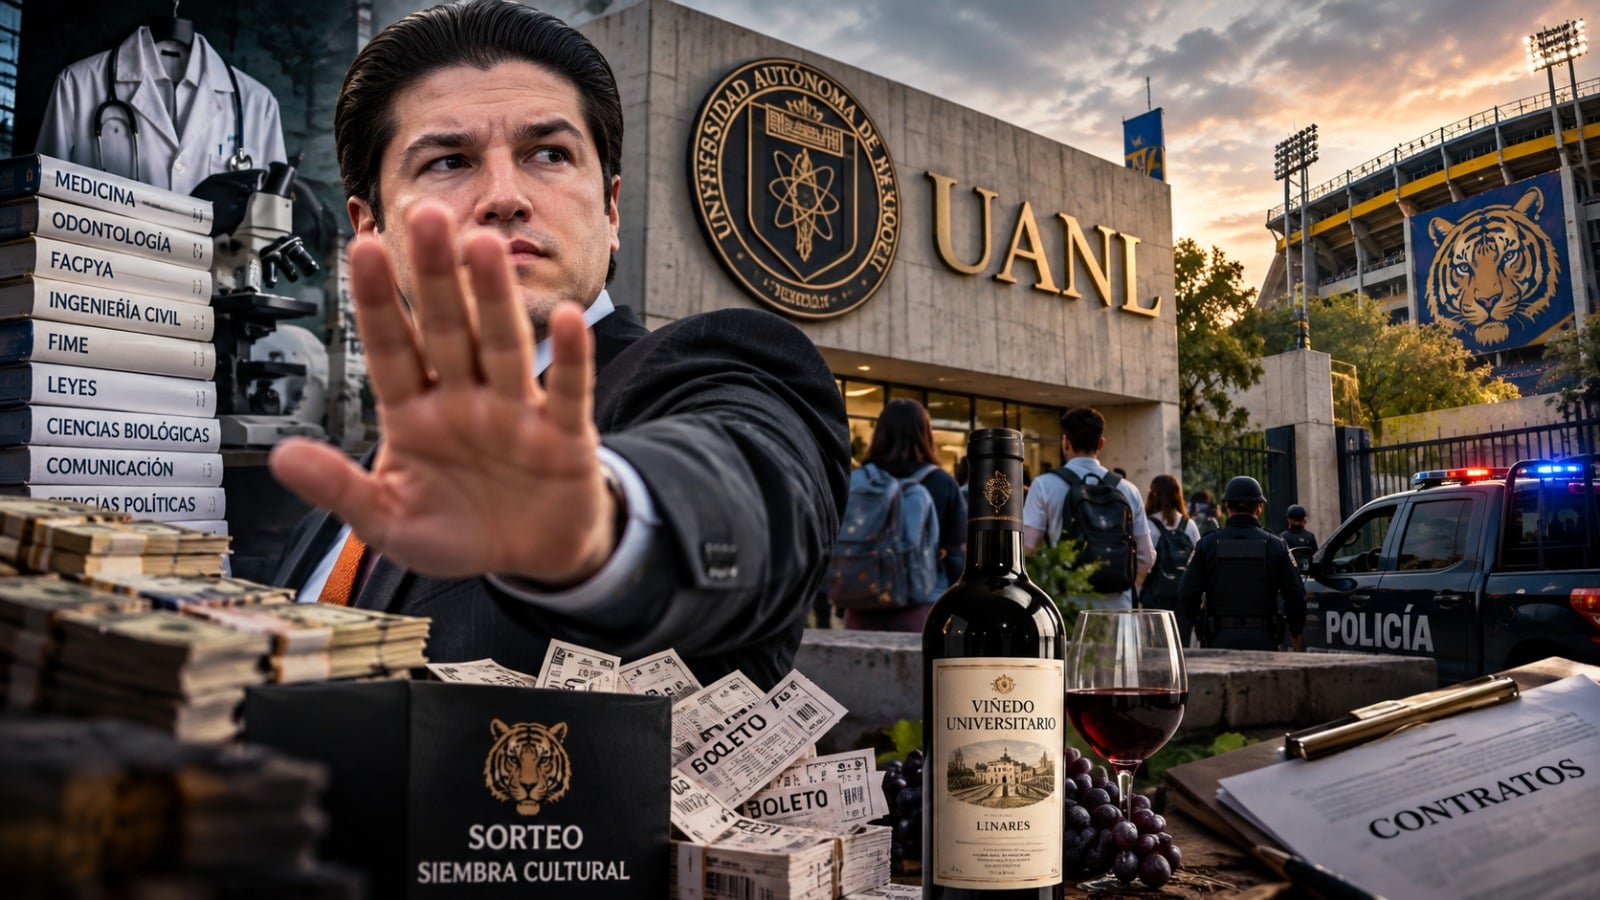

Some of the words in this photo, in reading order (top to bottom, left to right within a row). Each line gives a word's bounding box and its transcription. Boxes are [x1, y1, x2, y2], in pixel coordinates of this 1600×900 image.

[754, 65, 857, 124] AUTÓNOMA
[858, 118, 881, 151] DE
[55, 170, 136, 207] MEDICINA
[52, 212, 172, 253] ODONTOLOGÍA
[924, 171, 1162, 318] UANL
[50, 251, 114, 278] FACPYA
[144, 307, 181, 326] CIVIL
[48, 333, 89, 354] FIME
[48, 376, 97, 396] LEYES
[47, 417, 120, 438] CIENCIAS
[124, 421, 210, 443] BIOLÓGICAS
[46, 457, 174, 477] COMUNICACIÓN
[124, 493, 196, 513] POLÍTICAS
[1326, 603, 1434, 652] POLICÍA
[972, 697, 1035, 714] VIÑEDO
[946, 716, 1056, 731] UNIVERSITARIO
[748, 789, 828, 820] BOLETO
[1368, 758, 1586, 840] CONTRATOS
[468, 824, 584, 850] SORTEO
[976, 820, 1031, 831] LINARES
[417, 861, 518, 884] SIEMBRA
[523, 860, 631, 882] CULTURAL
